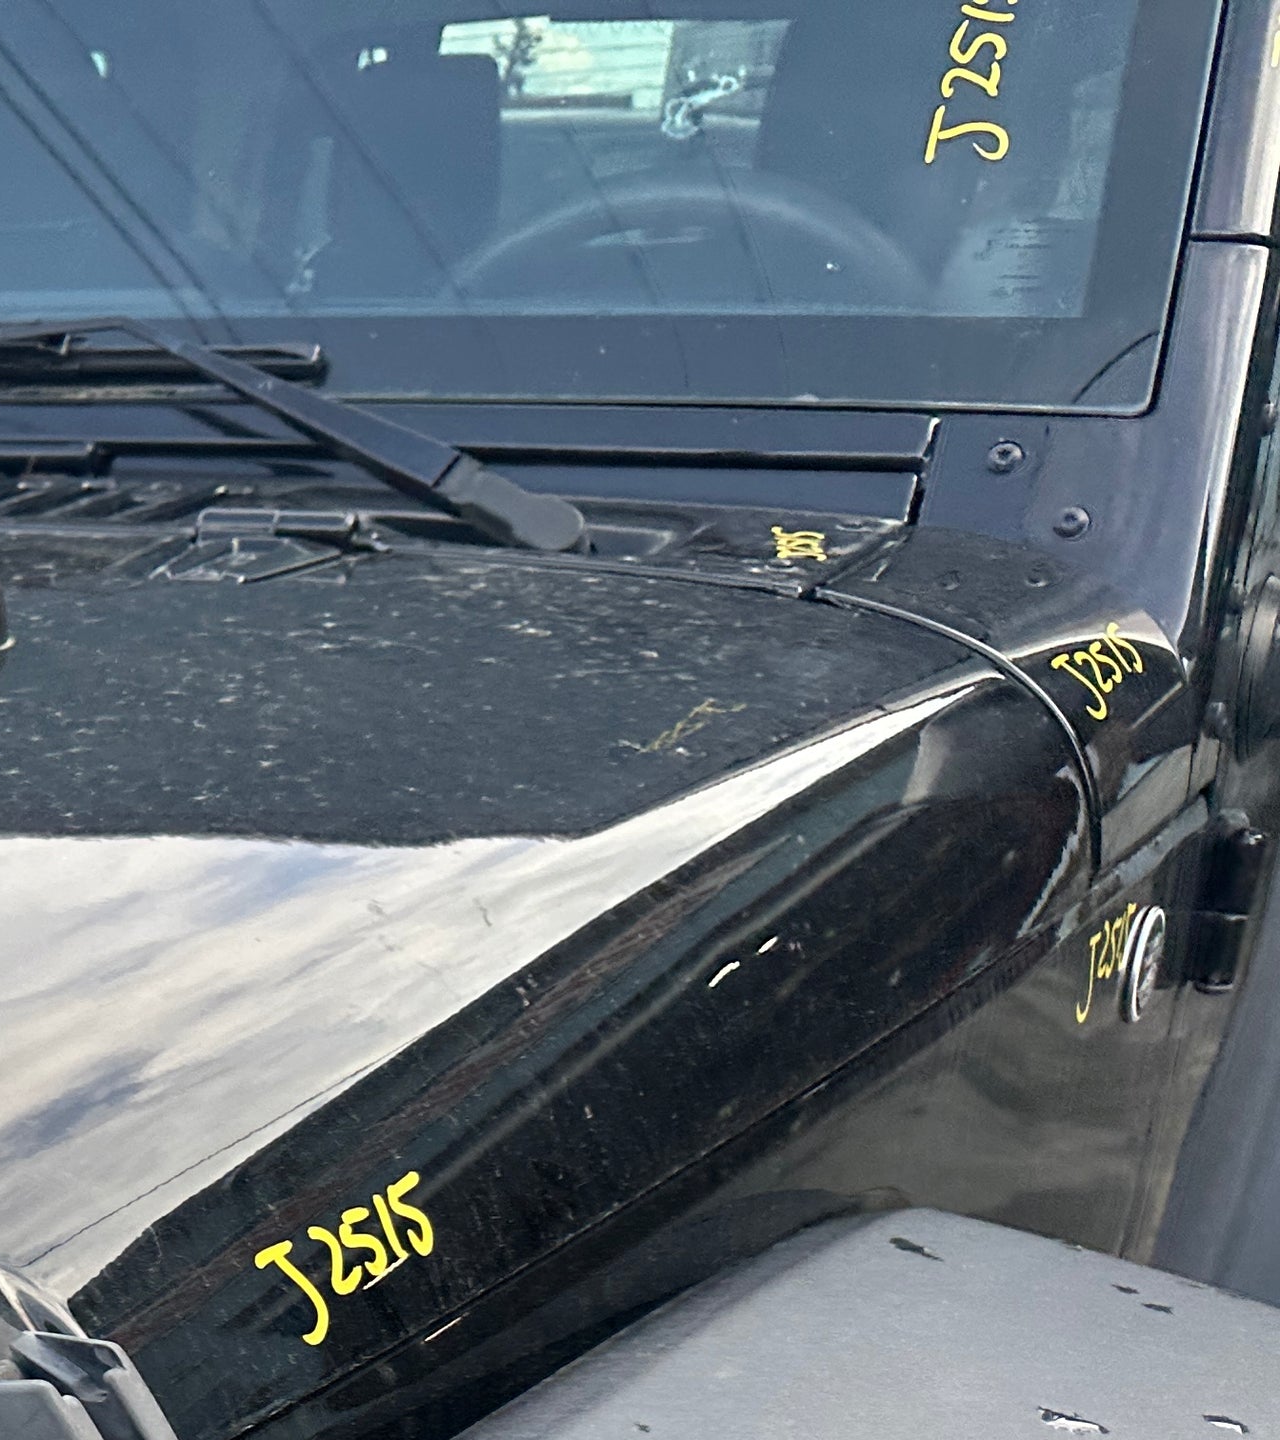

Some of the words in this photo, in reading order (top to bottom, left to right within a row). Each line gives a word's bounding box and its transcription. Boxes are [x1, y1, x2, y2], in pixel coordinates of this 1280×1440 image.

[924, 0, 1018, 163] J251
[1051, 622, 1143, 720] J2515
[254, 1170, 434, 1346] J2515
